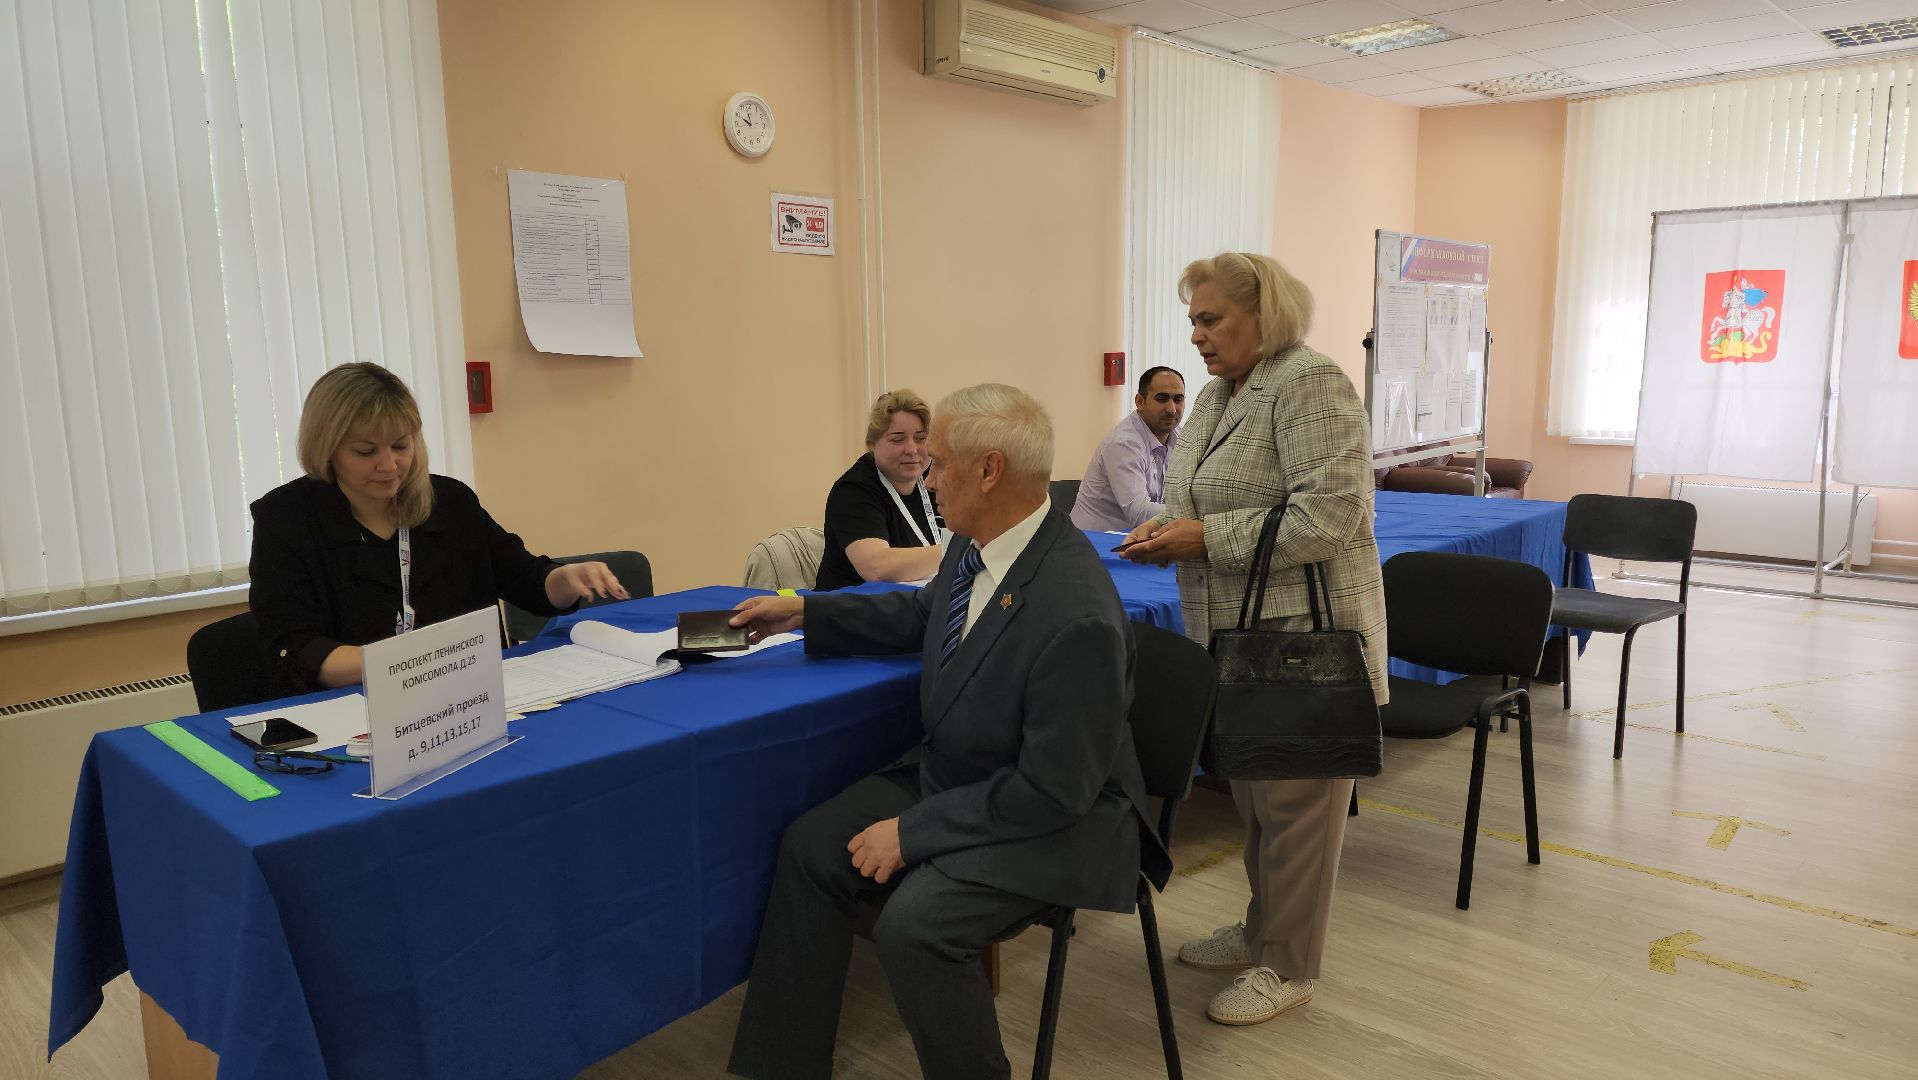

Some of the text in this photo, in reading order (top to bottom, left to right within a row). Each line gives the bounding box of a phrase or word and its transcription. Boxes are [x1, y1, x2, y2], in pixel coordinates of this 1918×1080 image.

[780, 206, 826, 217] ВНИМАНИЕ!
[389, 634, 484, 676] ПРОСПЕКТ ЛЕНИНСКОГО
[402, 654, 476, 690] КОМСОМОЛА Д 25
[395, 691, 490, 739] Битцевский проезд
[408, 715, 481, 764] д. 9,11,13,15,17
